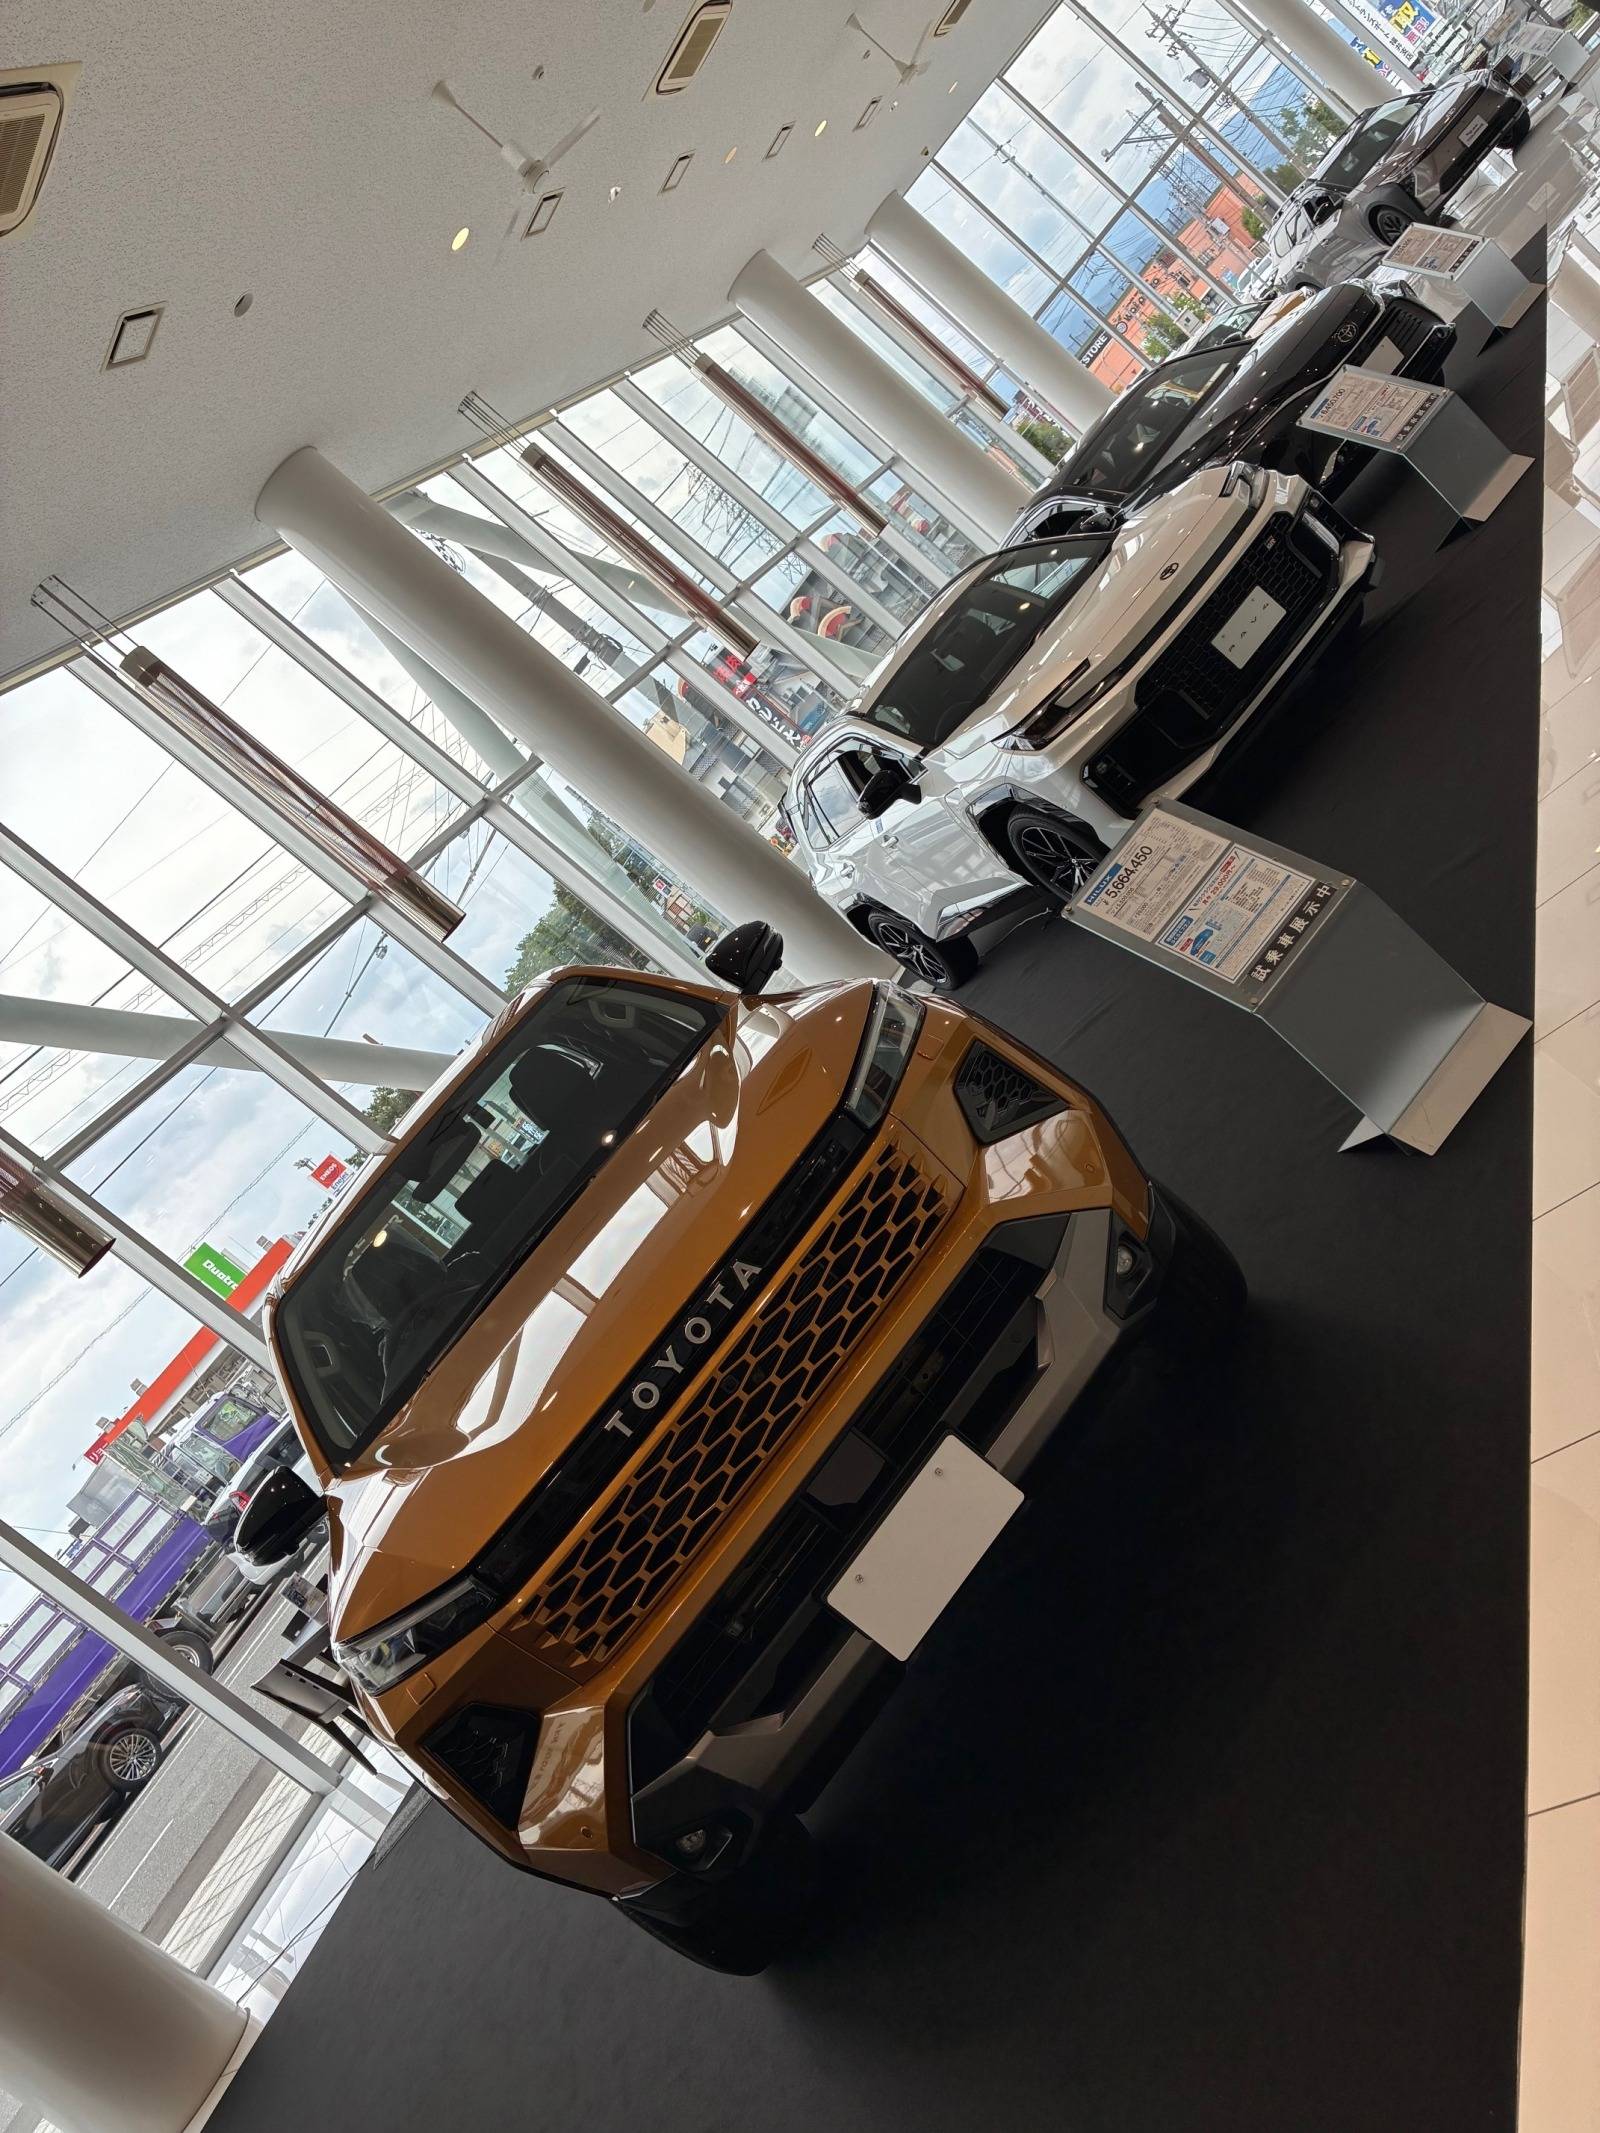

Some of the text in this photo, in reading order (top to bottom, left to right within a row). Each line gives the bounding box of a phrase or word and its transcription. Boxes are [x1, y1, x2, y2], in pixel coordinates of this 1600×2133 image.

[1087, 873, 1113, 904] HILUX
[1105, 845, 1153, 899] 5,664,450
[1251, 882, 1332, 982] 試乗車展示中
[320, 1162, 338, 1181] ENEOS
[603, 1260, 763, 1438] TOYOTA
